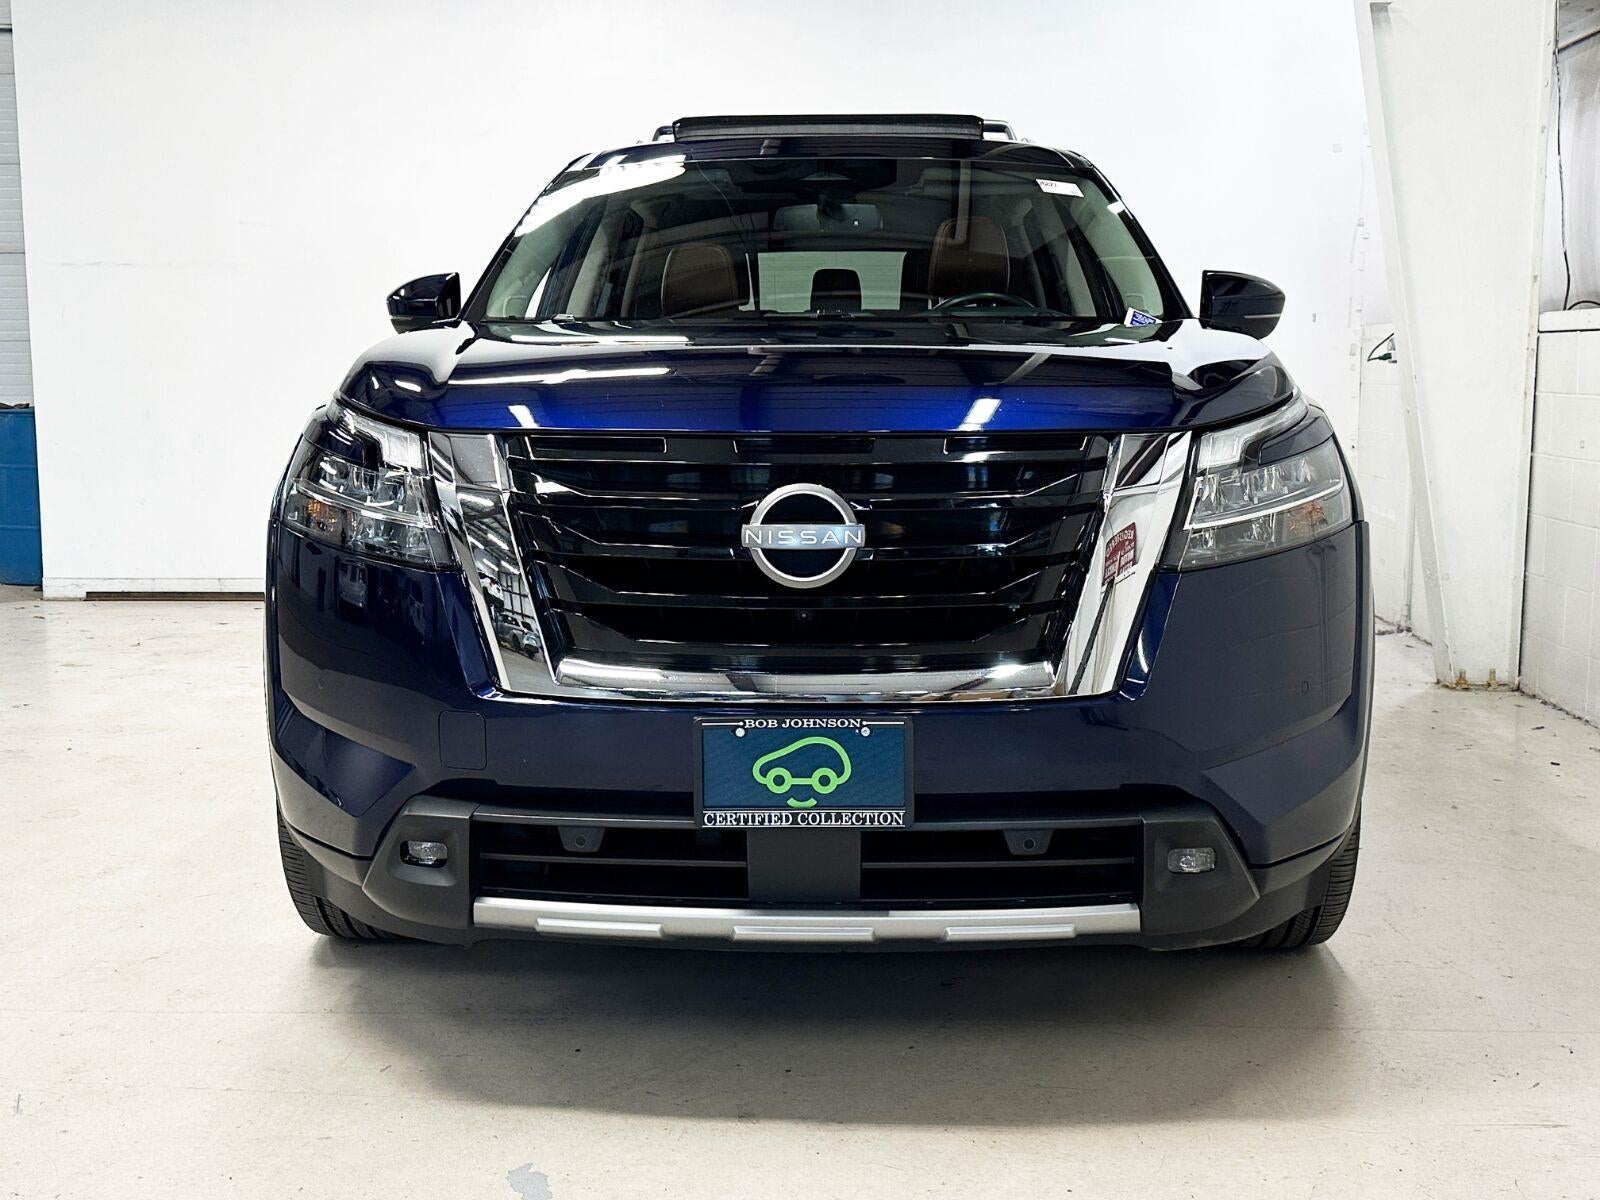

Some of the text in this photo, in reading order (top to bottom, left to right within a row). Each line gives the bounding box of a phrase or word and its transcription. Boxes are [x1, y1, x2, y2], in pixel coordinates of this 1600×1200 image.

[745, 530, 861, 544] NISSAN
[744, 718, 862, 728] BOB JOHNSON
[703, 812, 904, 826] CERTIFIED COLLECTION
